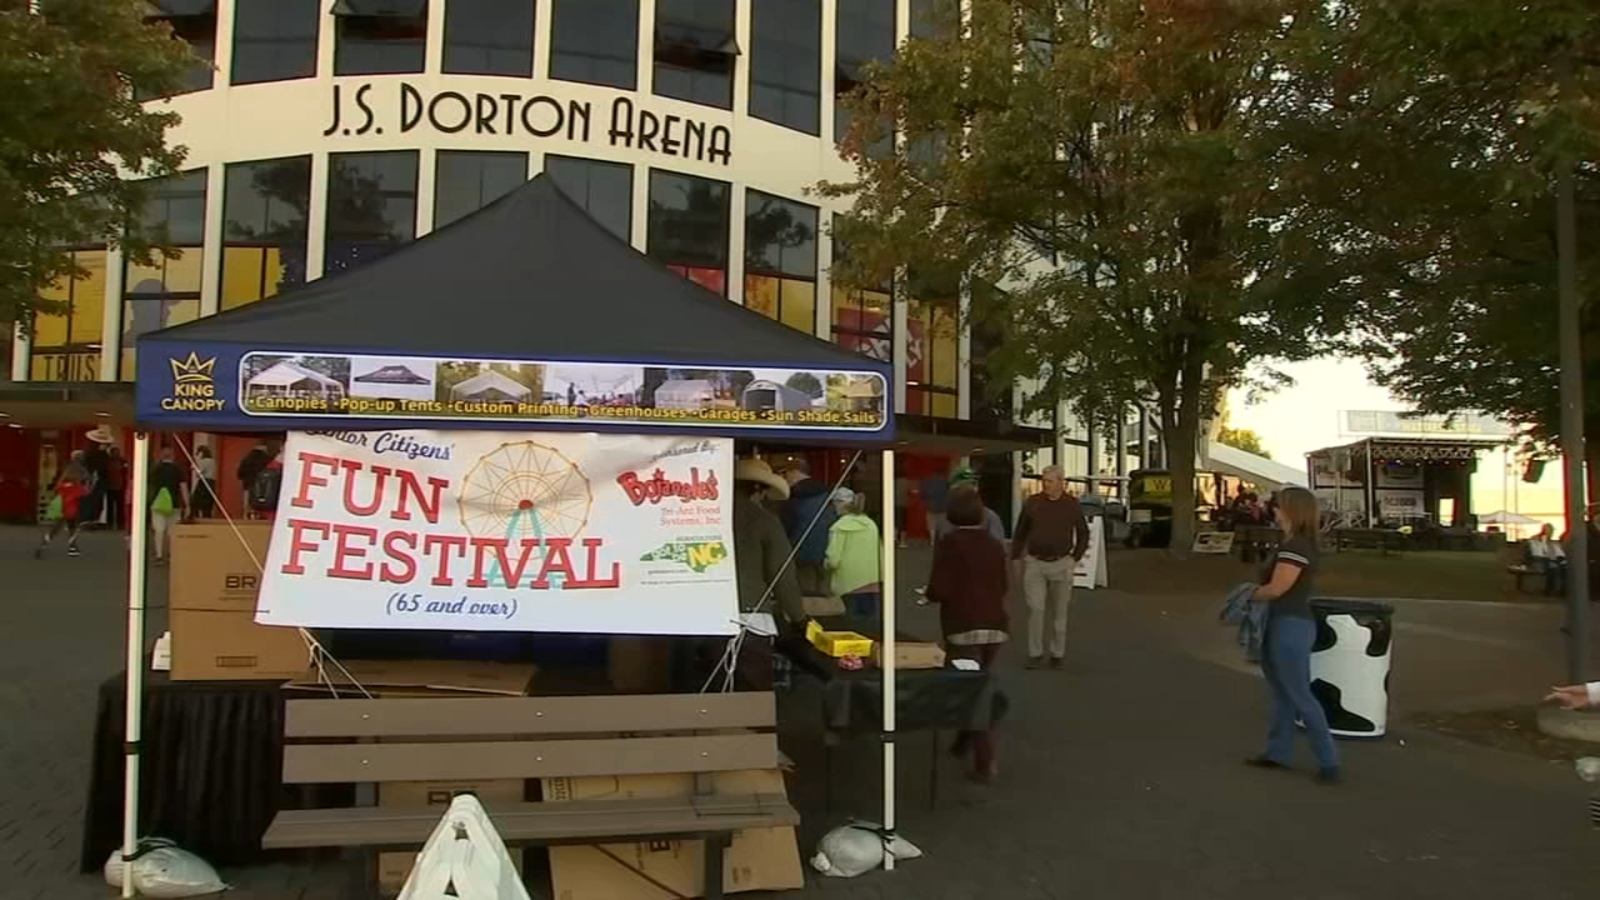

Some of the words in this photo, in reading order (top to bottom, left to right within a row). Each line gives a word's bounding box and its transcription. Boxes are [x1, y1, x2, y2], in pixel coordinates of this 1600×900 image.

[323, 83, 384, 136] J.S.
[400, 82, 591, 142] DORTON
[609, 96, 733, 166] ARENA
[174, 384, 214, 397] KING
[161, 398, 226, 411] CANOPY
[340, 398, 395, 414] Pop-up
[400, 400, 442, 413] Tents
[454, 401, 512, 415] Custom
[518, 402, 578, 418] Printing
[590, 404, 686, 419] Greenhouses
[699, 407, 757, 423] Garages
[767, 409, 794, 422] Sun
[799, 410, 840, 424] Shade
[844, 411, 875, 425] Sails
[291, 452, 449, 524] FUN
[281, 519, 621, 590] FESTIVAL
[687, 543, 722, 569] NC
[386, 592, 423, 616] (65
[425, 596, 468, 613] and
[468, 598, 518, 620] over)
